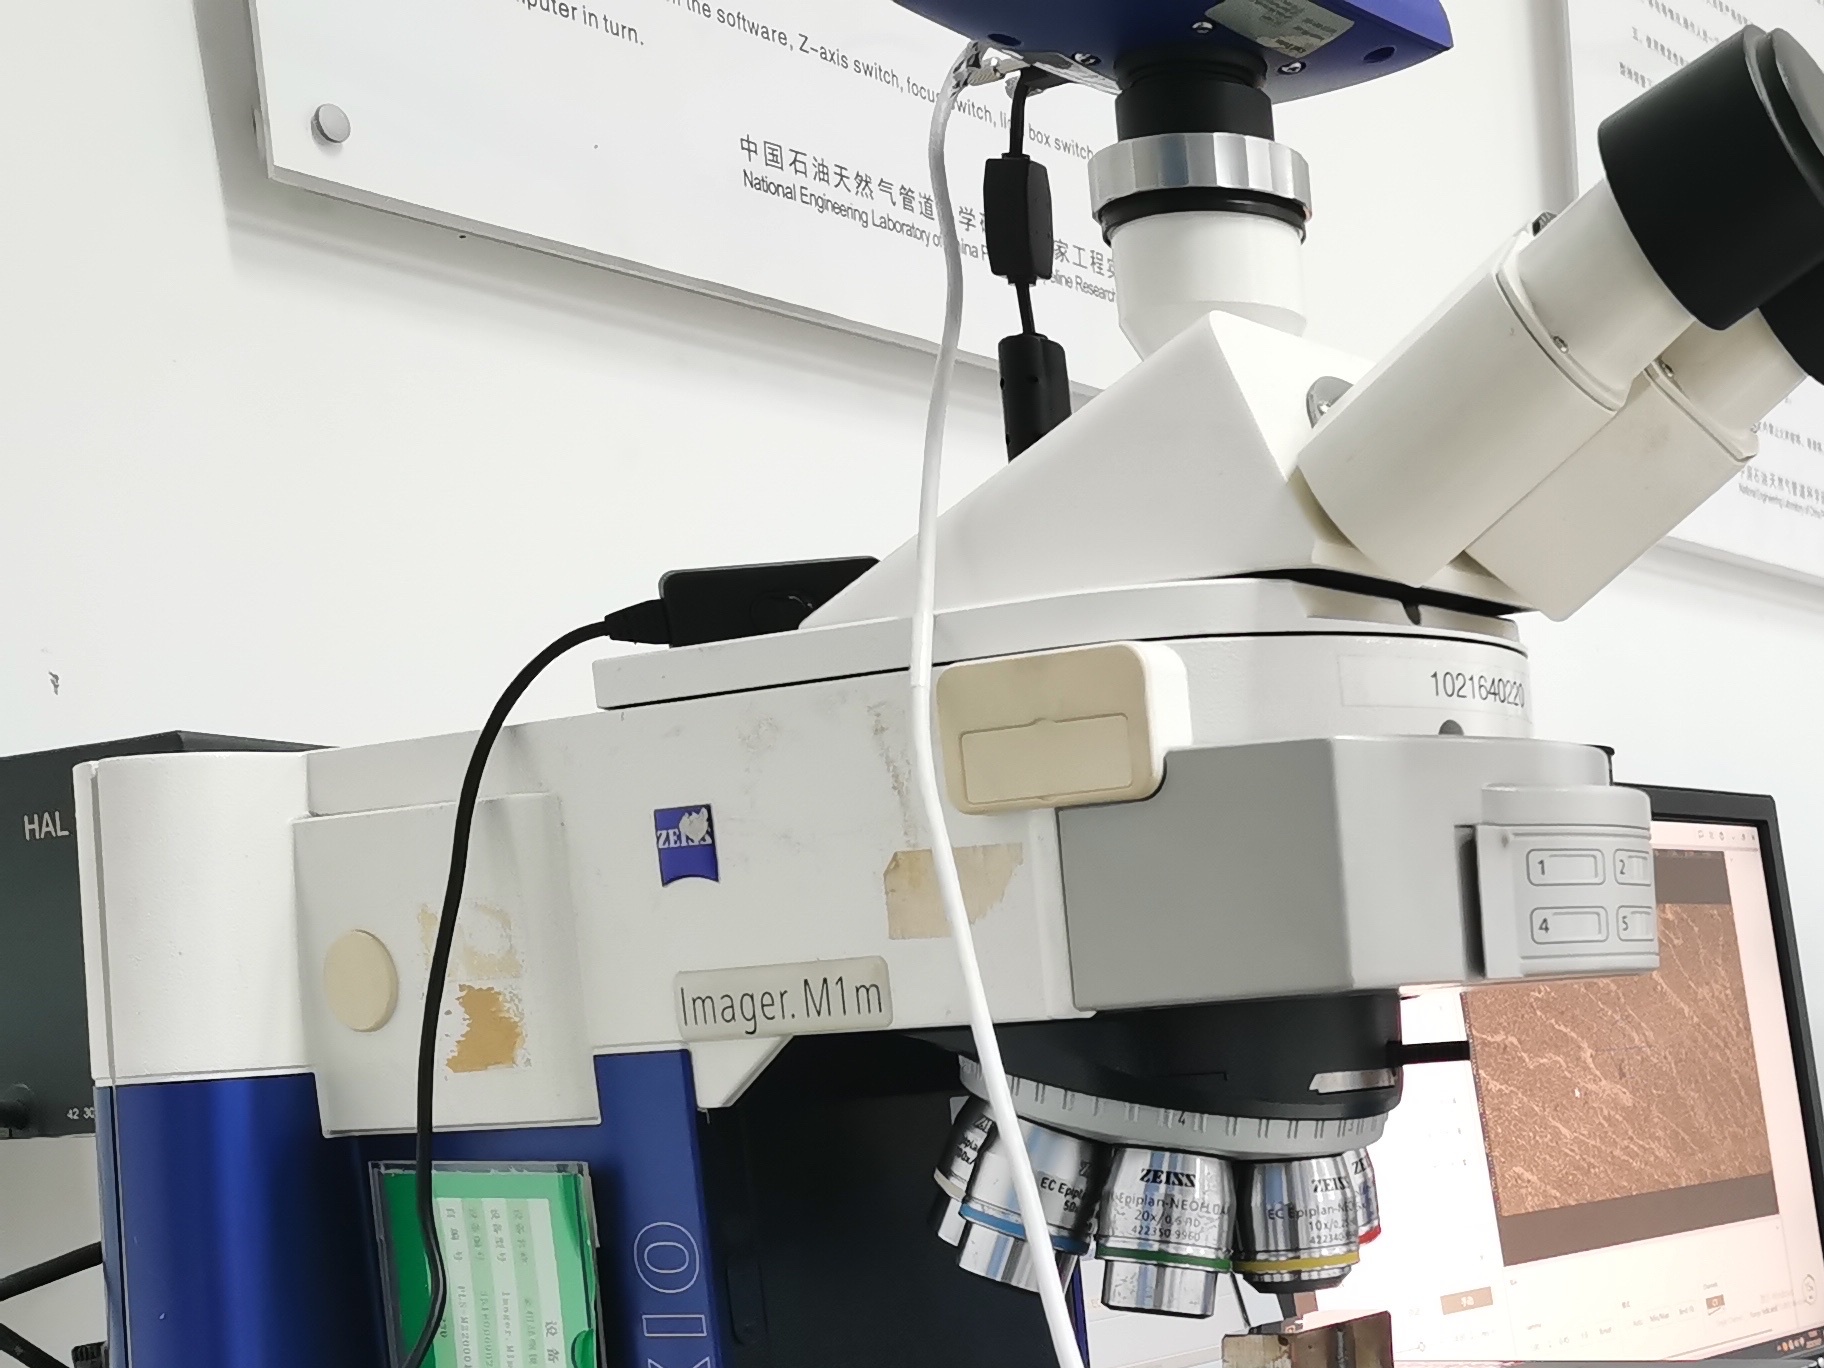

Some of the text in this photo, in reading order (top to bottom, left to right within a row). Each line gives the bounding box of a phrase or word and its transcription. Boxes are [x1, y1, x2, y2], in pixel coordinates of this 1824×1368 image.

[582, 5, 599, 29] in
[603, 14, 645, 46] turn.
[716, 8, 794, 51] software,
[798, 33, 849, 69] Z-axis
[853, 59, 904, 93] switch,
[953, 98, 997, 128] witch,
[1028, 122, 1051, 147] box
[743, 168, 796, 201] National
[800, 186, 869, 229] Engineering
[871, 209, 931, 248] Laboratory
[1430, 671, 1525, 708] 1021640220
[24, 810, 70, 841] HAL
[1538, 859, 1626, 876] 1 2
[1538, 916, 1628, 934] 4 5
[66, 1107, 80, 1121] 42
[1040, 1176, 1057, 1192] EC
[1139, 1168, 1197, 1188] ZEISS
